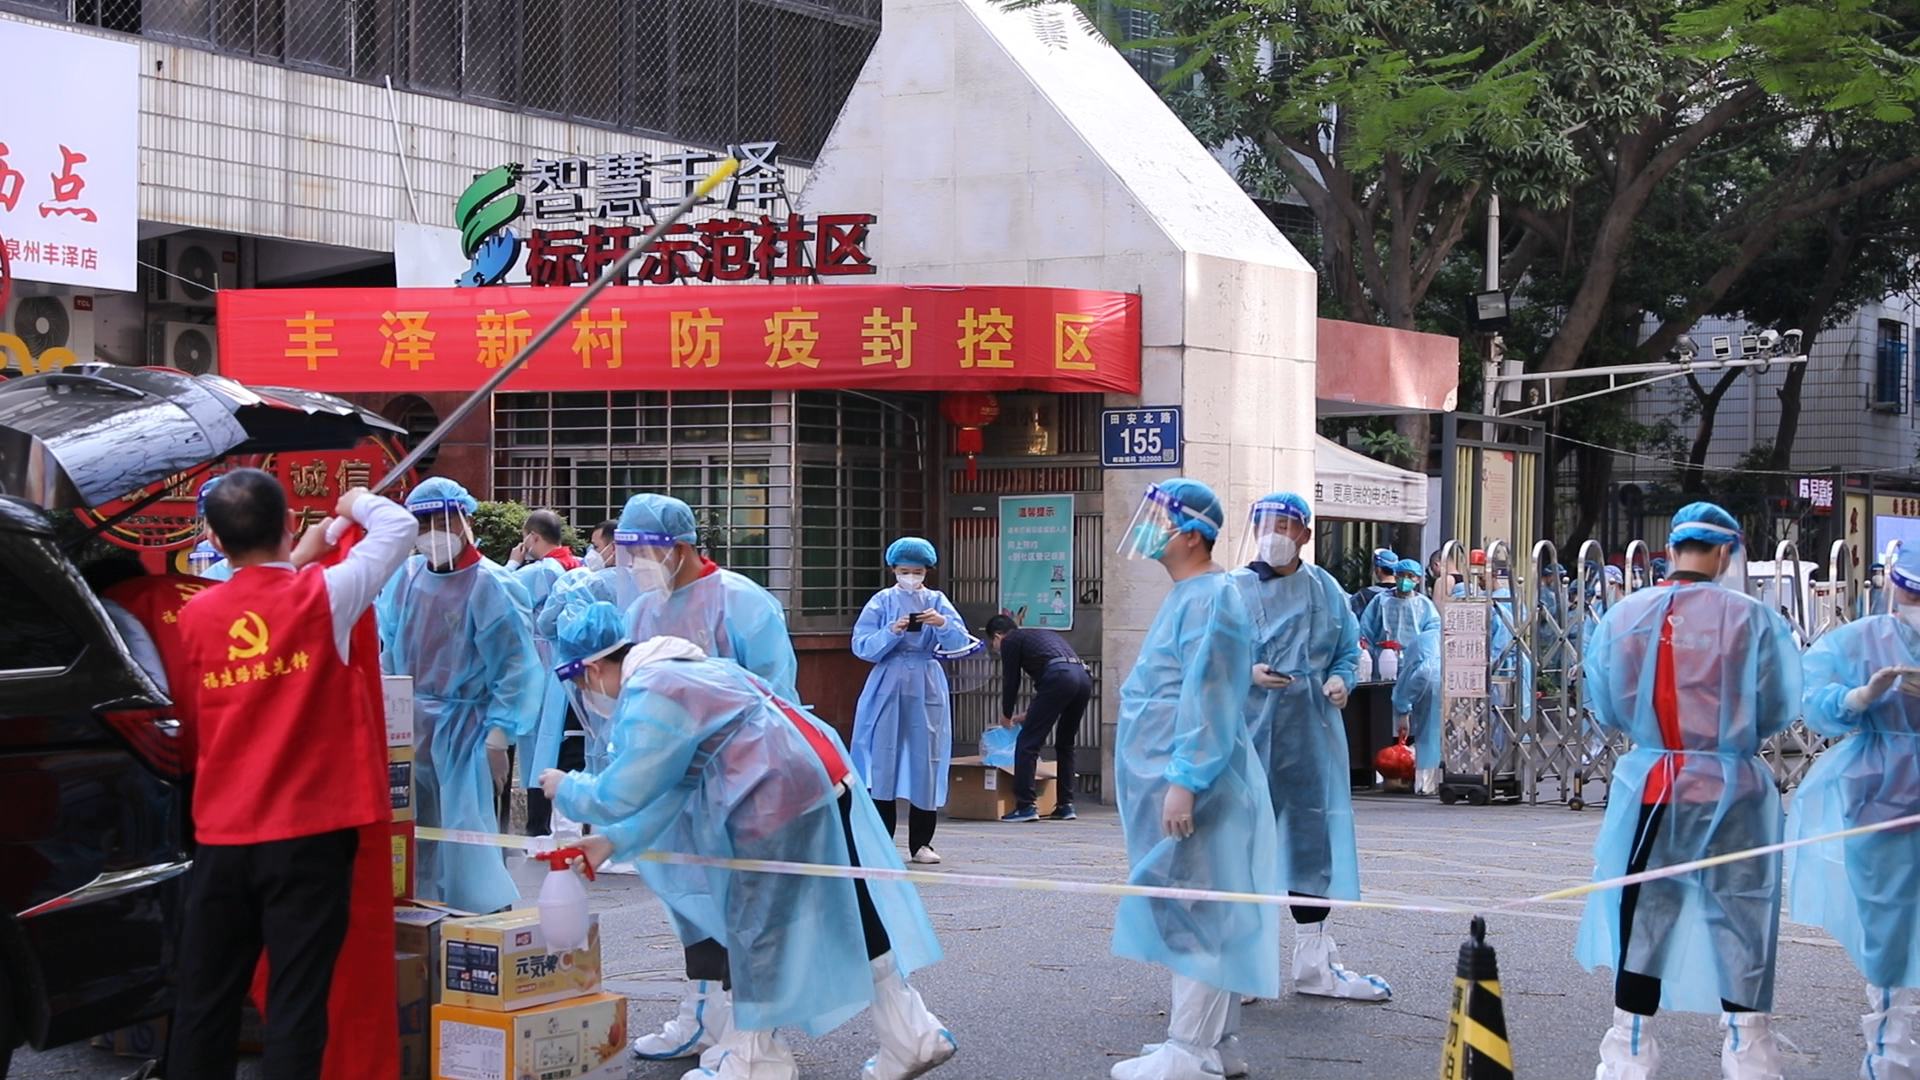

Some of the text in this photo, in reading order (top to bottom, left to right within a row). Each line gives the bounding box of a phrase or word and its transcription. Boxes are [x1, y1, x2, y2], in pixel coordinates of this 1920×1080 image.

[531, 141, 780, 225] 智慧丰泽
[6, 238, 98, 271] 泉州丰泽店
[526, 213, 877, 287] 标杆示范社区
[284, 308, 1096, 372] 丰泽新村防疫封控区
[1110, 412, 1171, 425] 田安北路
[1120, 427, 1161, 454] 155
